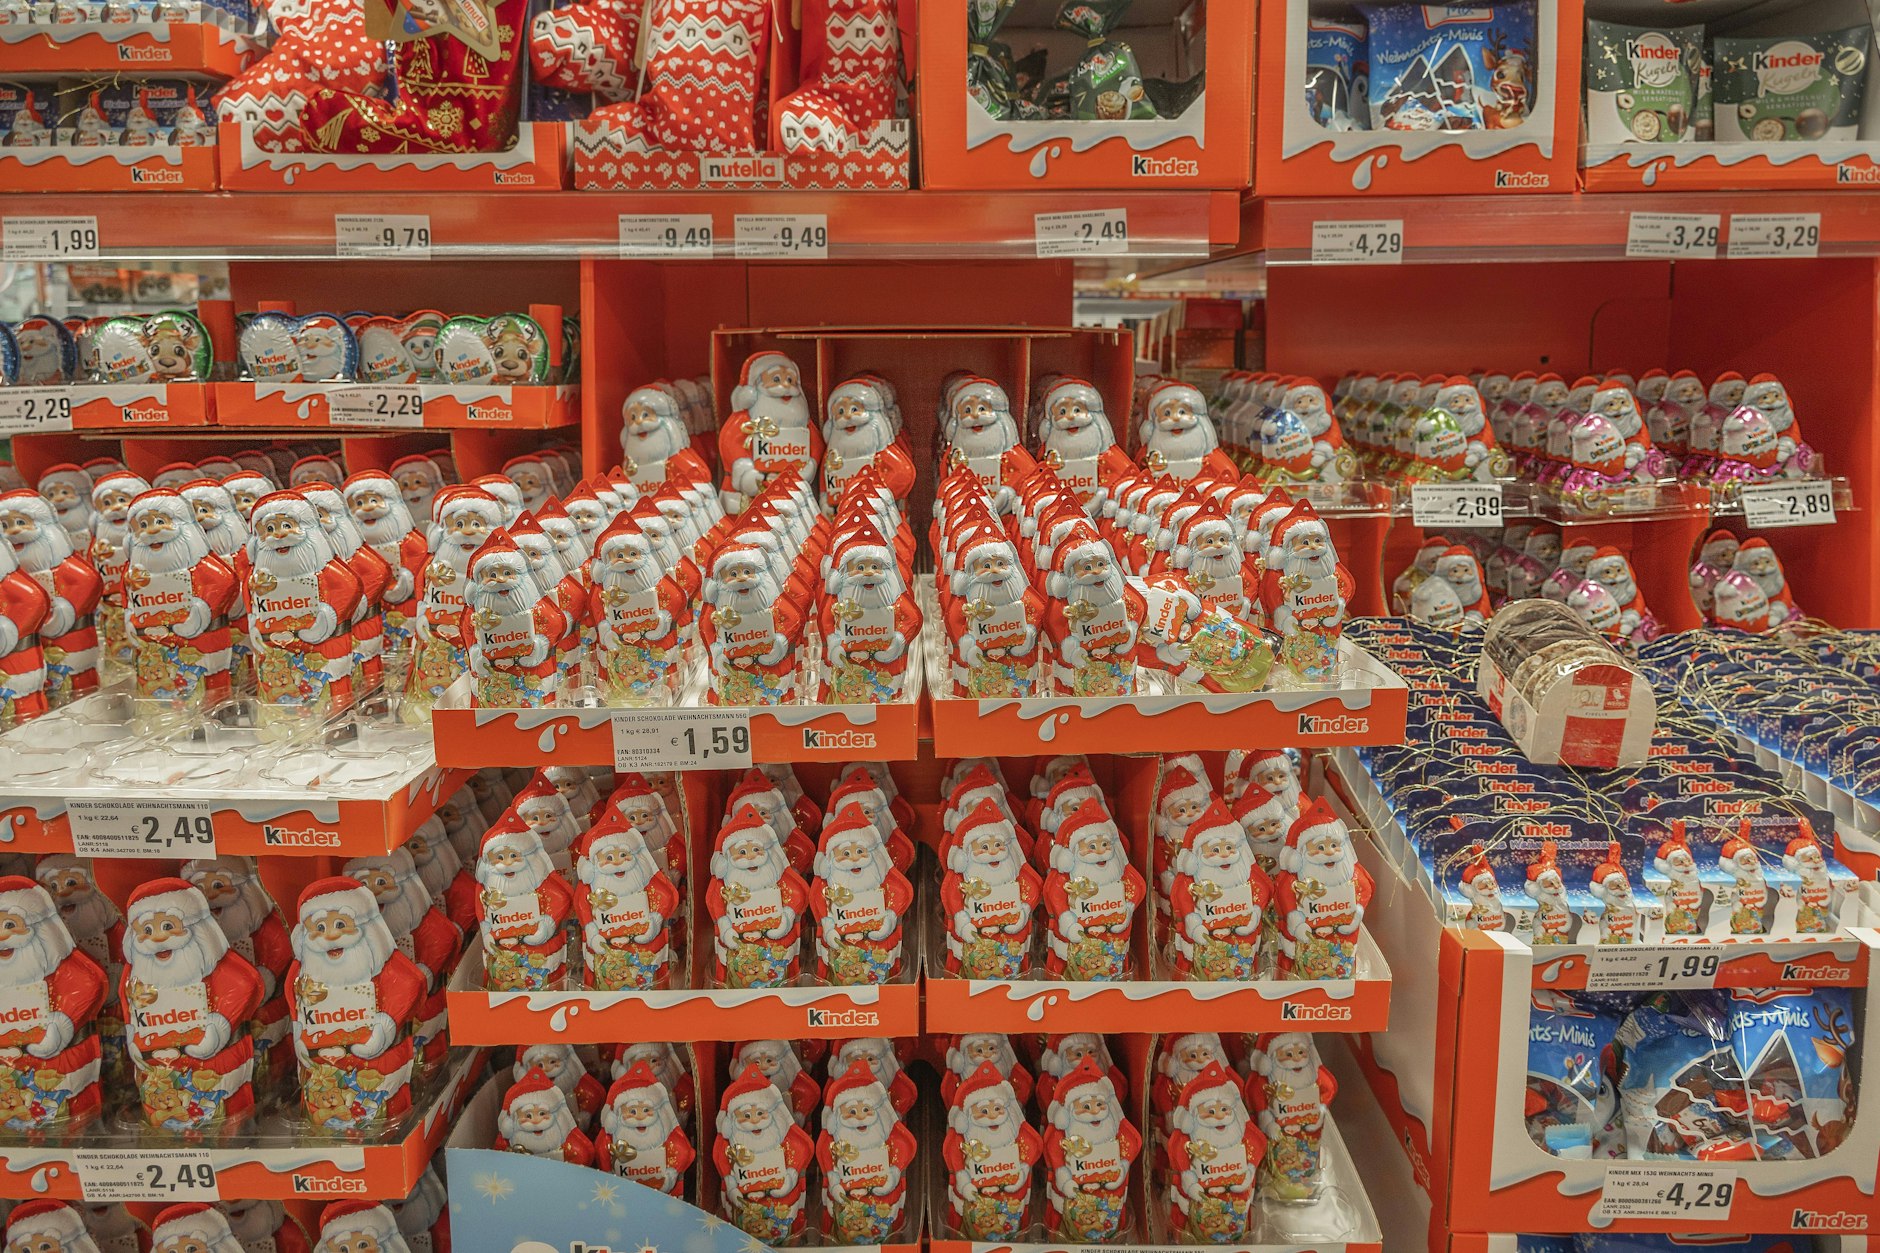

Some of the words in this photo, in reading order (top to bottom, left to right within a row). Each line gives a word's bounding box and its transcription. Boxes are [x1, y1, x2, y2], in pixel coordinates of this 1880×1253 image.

[120, 46, 169, 59] Kinder
[1376, 30, 1484, 65] Weihnachts-Minis
[1628, 43, 1680, 60] Kinder
[1756, 53, 1822, 70] Kinder
[1635, 63, 1680, 89] Kugeln
[709, 158, 775, 178] nutella
[1133, 158, 1196, 175] Kinder
[133, 169, 182, 182] Kinder
[495, 172, 534, 184] Kinder
[1497, 172, 1546, 186] Kinder
[383, 228, 429, 251] 9,79
[665, 228, 711, 248] 9,49
[781, 227, 826, 250] 9,49
[1082, 221, 1126, 245] 2,49
[1673, 226, 1719, 249] 3,29
[1773, 226, 1818, 250] 3,29
[52, 230, 96, 253] 1,99
[1357, 233, 1401, 256] 4,29
[106, 357, 136, 371] Kinder
[254, 354, 286, 365] Kinder
[368, 357, 397, 371] Kinder
[450, 358, 480, 371] Kinder
[25, 398, 70, 422] 2,29
[377, 394, 423, 417] 2,29
[124, 409, 167, 420] Kinder
[468, 407, 511, 419] Kinder
[758, 441, 806, 456] Kinder
[1457, 497, 1500, 518] 2,89
[1787, 494, 1830, 517] 2,89
[131, 591, 184, 607] Kinder
[257, 597, 310, 612] Kinder
[1295, 594, 1333, 605] Kinder
[613, 606, 653, 620] Kinder
[1151, 600, 1172, 636] Kinder
[844, 624, 887, 636] Kinder
[979, 620, 1022, 635] Kinder
[1082, 620, 1125, 636] Kinder
[484, 630, 530, 644] Kinder
[724, 630, 768, 643] Kinder
[1381, 646, 1421, 659] Kinder
[1300, 716, 1365, 733] Kinder
[1440, 724, 1486, 737] Kinder
[671, 737, 679, 746] €
[684, 726, 749, 758] 1,59
[806, 731, 875, 748] Kinder
[1452, 741, 1500, 755] Kinder
[1467, 759, 1515, 773] Kinder
[1481, 778, 1533, 791] Kinder
[1680, 779, 1732, 793] Kinder
[1497, 797, 1548, 811] Kinder
[1705, 800, 1758, 814] Kinder
[131, 825, 140, 834] €
[142, 816, 213, 847] 2,49
[1514, 821, 1568, 837] Kinder
[266, 827, 334, 846] Kinder
[1672, 889, 1698, 897] Kinder
[1739, 888, 1765, 897] Kinder
[1801, 886, 1827, 896] Kinder
[734, 906, 776, 918] Kinder
[837, 907, 878, 921] Kinder
[974, 902, 1015, 914] Kinder
[1081, 900, 1123, 914] Kinder
[1206, 903, 1246, 916] Kinder
[1309, 901, 1350, 914] Kinder
[491, 912, 533, 924] Kinder
[601, 912, 643, 925] Kinder
[1477, 914, 1502, 922] Kinder
[1541, 912, 1566, 921] Kinder
[1607, 912, 1632, 921] Kinder
[1658, 955, 1719, 980] 1,99
[1783, 966, 1847, 981] Kinder
[135, 1007, 197, 1027] Kinder
[304, 1006, 366, 1025] Kinder
[809, 1010, 874, 1026] Kinder
[1283, 1003, 1348, 1020] Kinder
[1279, 1102, 1316, 1114] Kinder
[620, 1165, 661, 1177] Kinder
[843, 1163, 884, 1176] Kinder
[974, 1162, 1016, 1175] Kinder
[1076, 1158, 1116, 1171] Kinder
[1202, 1162, 1241, 1174] Kinder
[136, 1172, 144, 1180] €
[147, 1164, 215, 1191] 2,49
[738, 1166, 781, 1180] Kinder
[296, 1176, 362, 1192] Kinder
[1656, 1190, 1665, 1198] €
[1666, 1183, 1732, 1209] 4,29
[1793, 1210, 1866, 1229] Kinder
